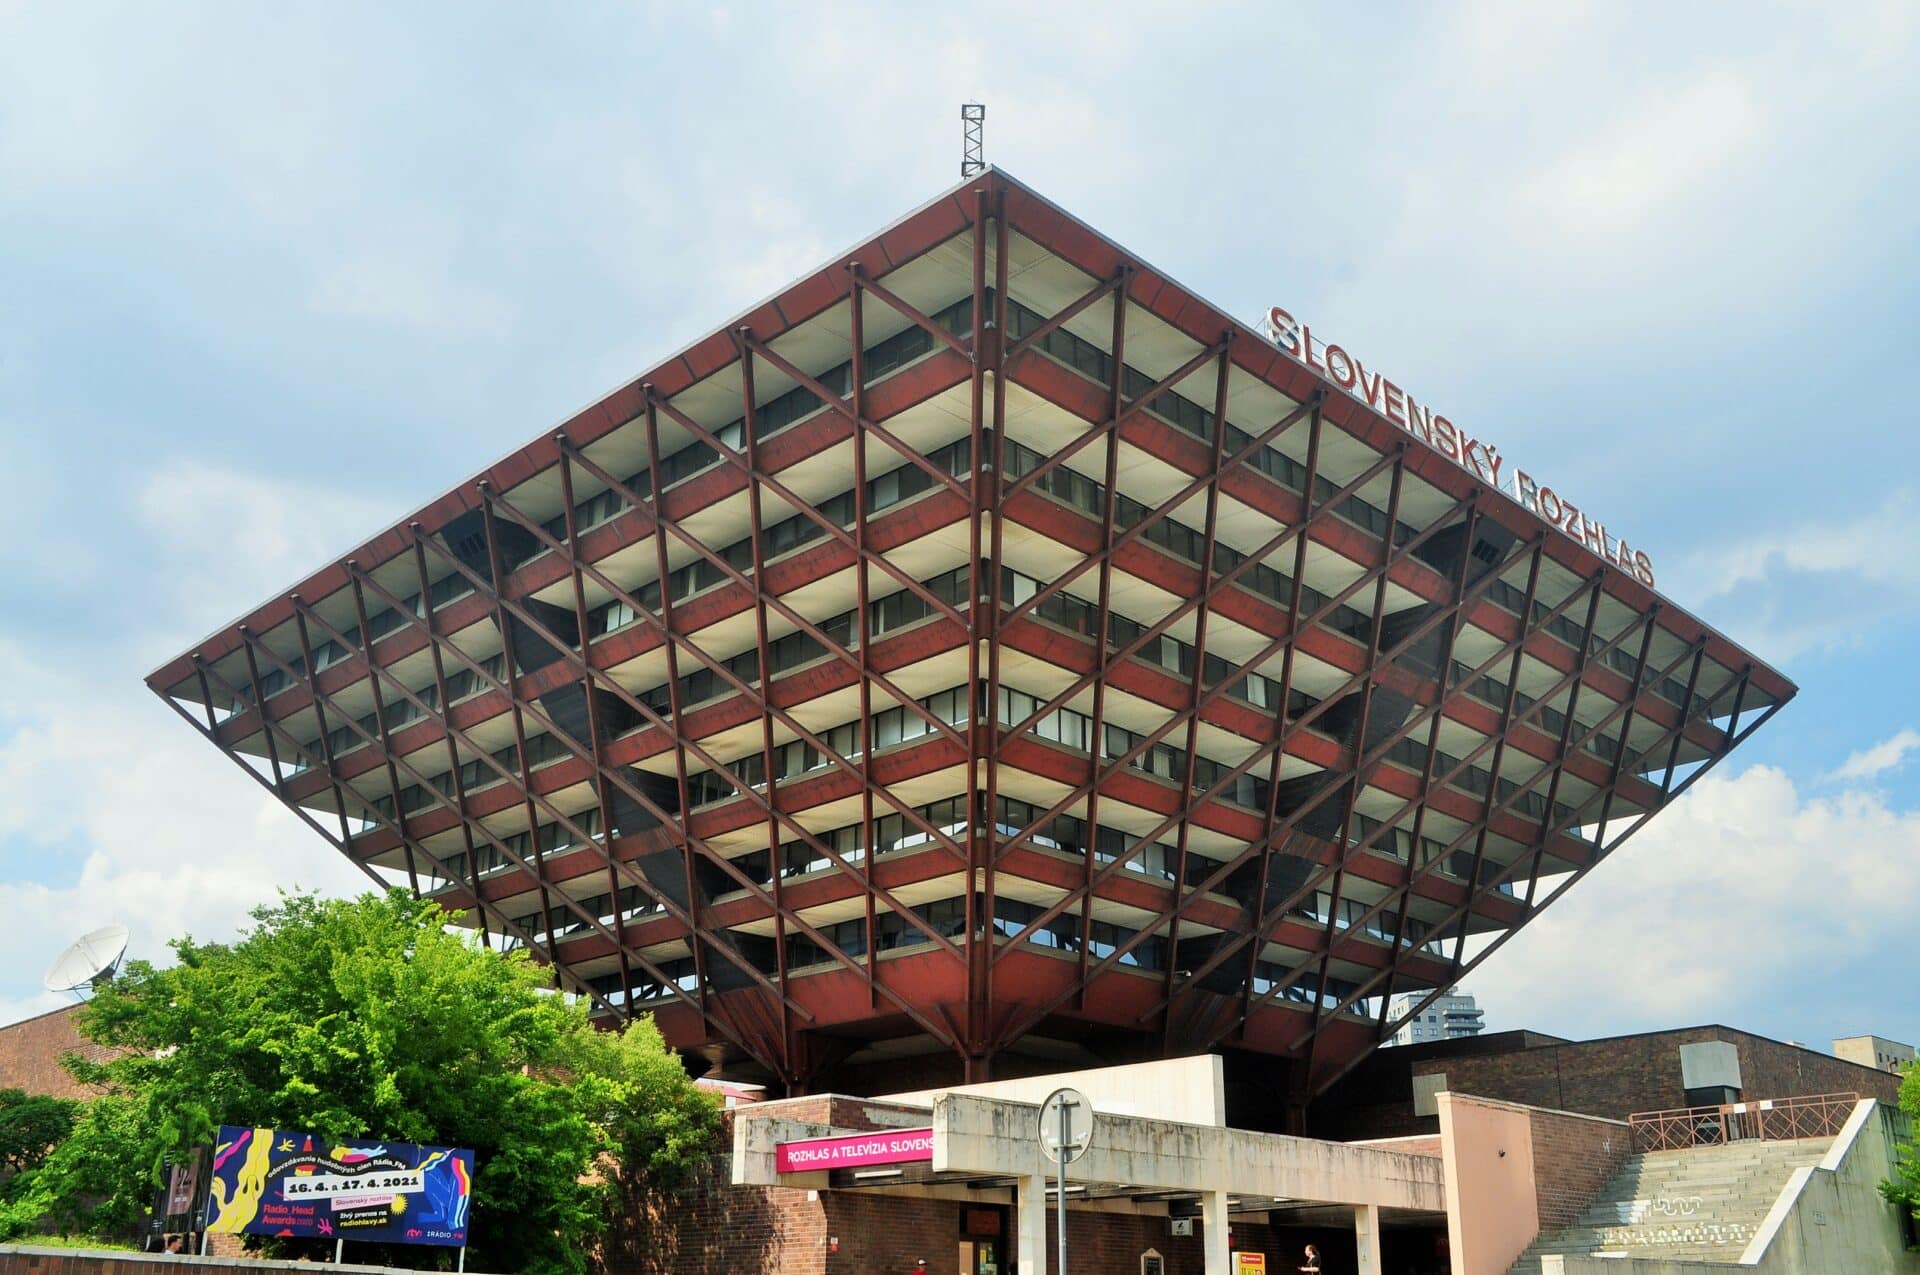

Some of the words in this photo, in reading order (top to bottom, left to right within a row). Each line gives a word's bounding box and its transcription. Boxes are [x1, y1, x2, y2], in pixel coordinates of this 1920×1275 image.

[1267, 306, 1502, 486] SLOVENSKÝ
[1514, 468, 1655, 588] ROZHLAS
[788, 1148, 829, 1163] ROZHLAS
[831, 1147, 839, 1159] A
[841, 1140, 888, 1157] TELEVÍZIA
[288, 1183, 312, 1193] 16.
[315, 1182, 329, 1192] 4.
[342, 1180, 364, 1190] 17.
[367, 1179, 380, 1188] 4.
[383, 1177, 419, 1187] 2021
